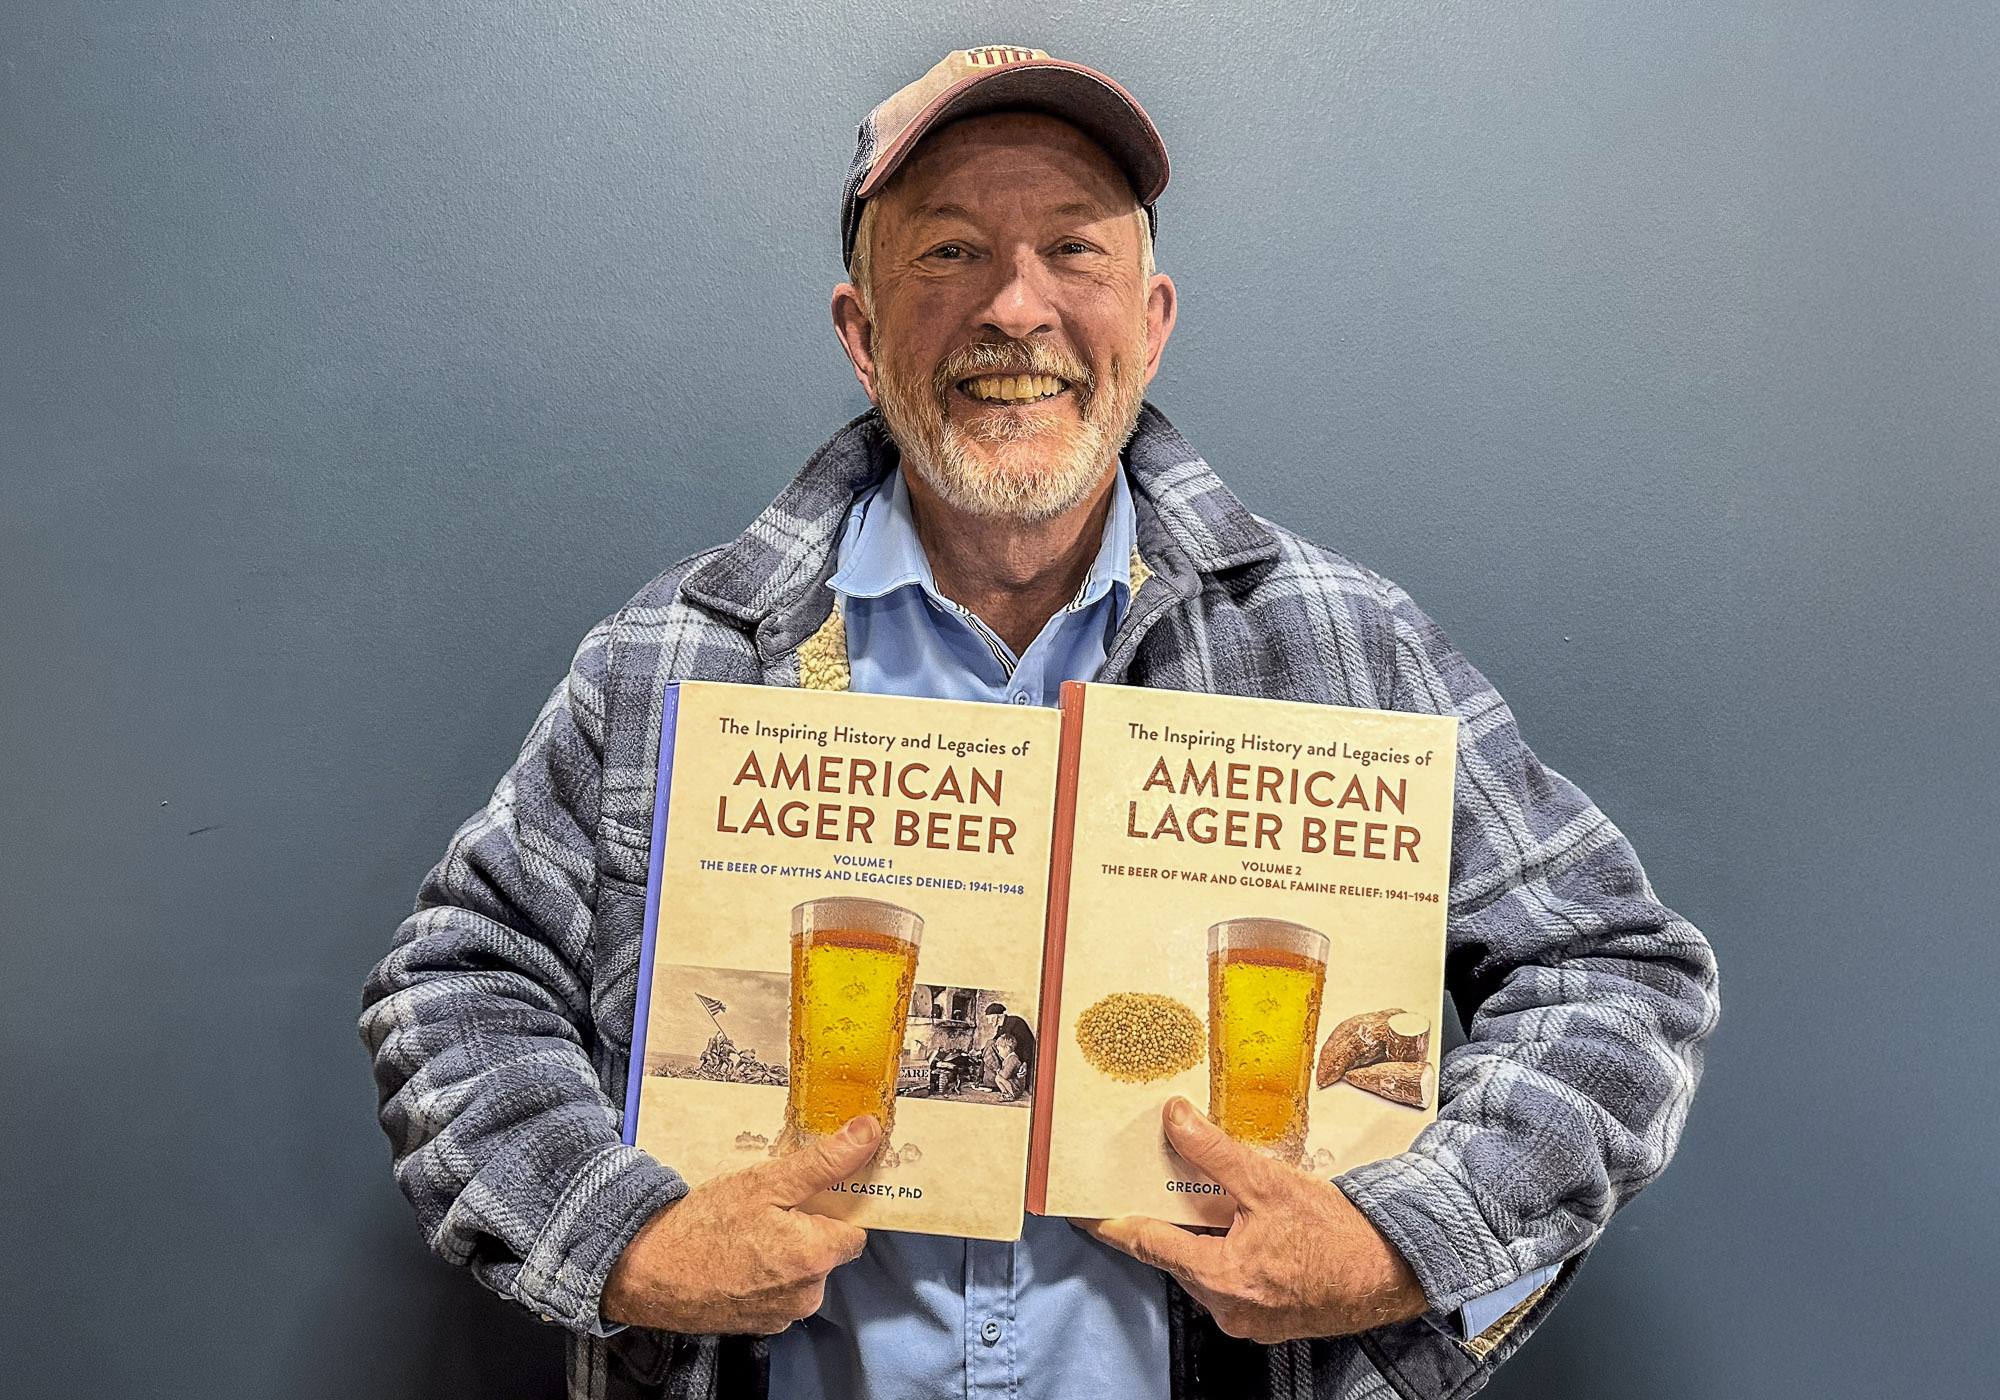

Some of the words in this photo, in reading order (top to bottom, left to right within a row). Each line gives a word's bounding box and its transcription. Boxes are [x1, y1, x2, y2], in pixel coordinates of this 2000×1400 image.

[719, 717, 750, 735] The
[756, 720, 827, 747] Inspiring
[834, 726, 896, 752] History
[900, 732, 932, 749] and
[938, 736, 1005, 757] Legacies
[1011, 740, 1031, 757] of
[1128, 722, 1159, 741] The
[1165, 726, 1235, 754] Inspiring
[1242, 734, 1302, 759] History
[1306, 741, 1337, 758] and
[1343, 744, 1409, 766] Legacies
[1414, 750, 1434, 767] of
[733, 750, 1003, 807] AMERICAN
[1142, 756, 1407, 816] AMERICAN
[717, 796, 875, 843] LAGER
[894, 810, 1016, 855] BEER
[1127, 800, 1282, 850] LAGER
[1302, 817, 1421, 863] BEER
[700, 859, 724, 871] THE
[726, 861, 758, 874] BEER
[760, 864, 778, 875] OF
[779, 865, 822, 879] MYTHS
[823, 869, 852, 881] AND
[854, 871, 913, 886] LEGACIES
[915, 876, 967, 891] DENIED:
[833, 854, 885, 868] VOLUME
[887, 859, 894, 869] 1
[1241, 860, 1293, 875] VOLUME
[1295, 865, 1302, 876] 2
[1101, 863, 1125, 876] THE
[1127, 866, 1159, 879] BEER
[1161, 869, 1178, 880] OF
[1180, 870, 1208, 883] WAR
[1210, 873, 1237, 885] AND
[1239, 876, 1287, 890] GLOBAL
[1289, 880, 1337, 895] FAMINE
[1339, 884, 1383, 899] RELIEF:
[899, 1069, 929, 1078] CARE
[825, 1181, 847, 1193] UL
[850, 1182, 895, 1200] CASEY,
[898, 1186, 923, 1199] PhD
